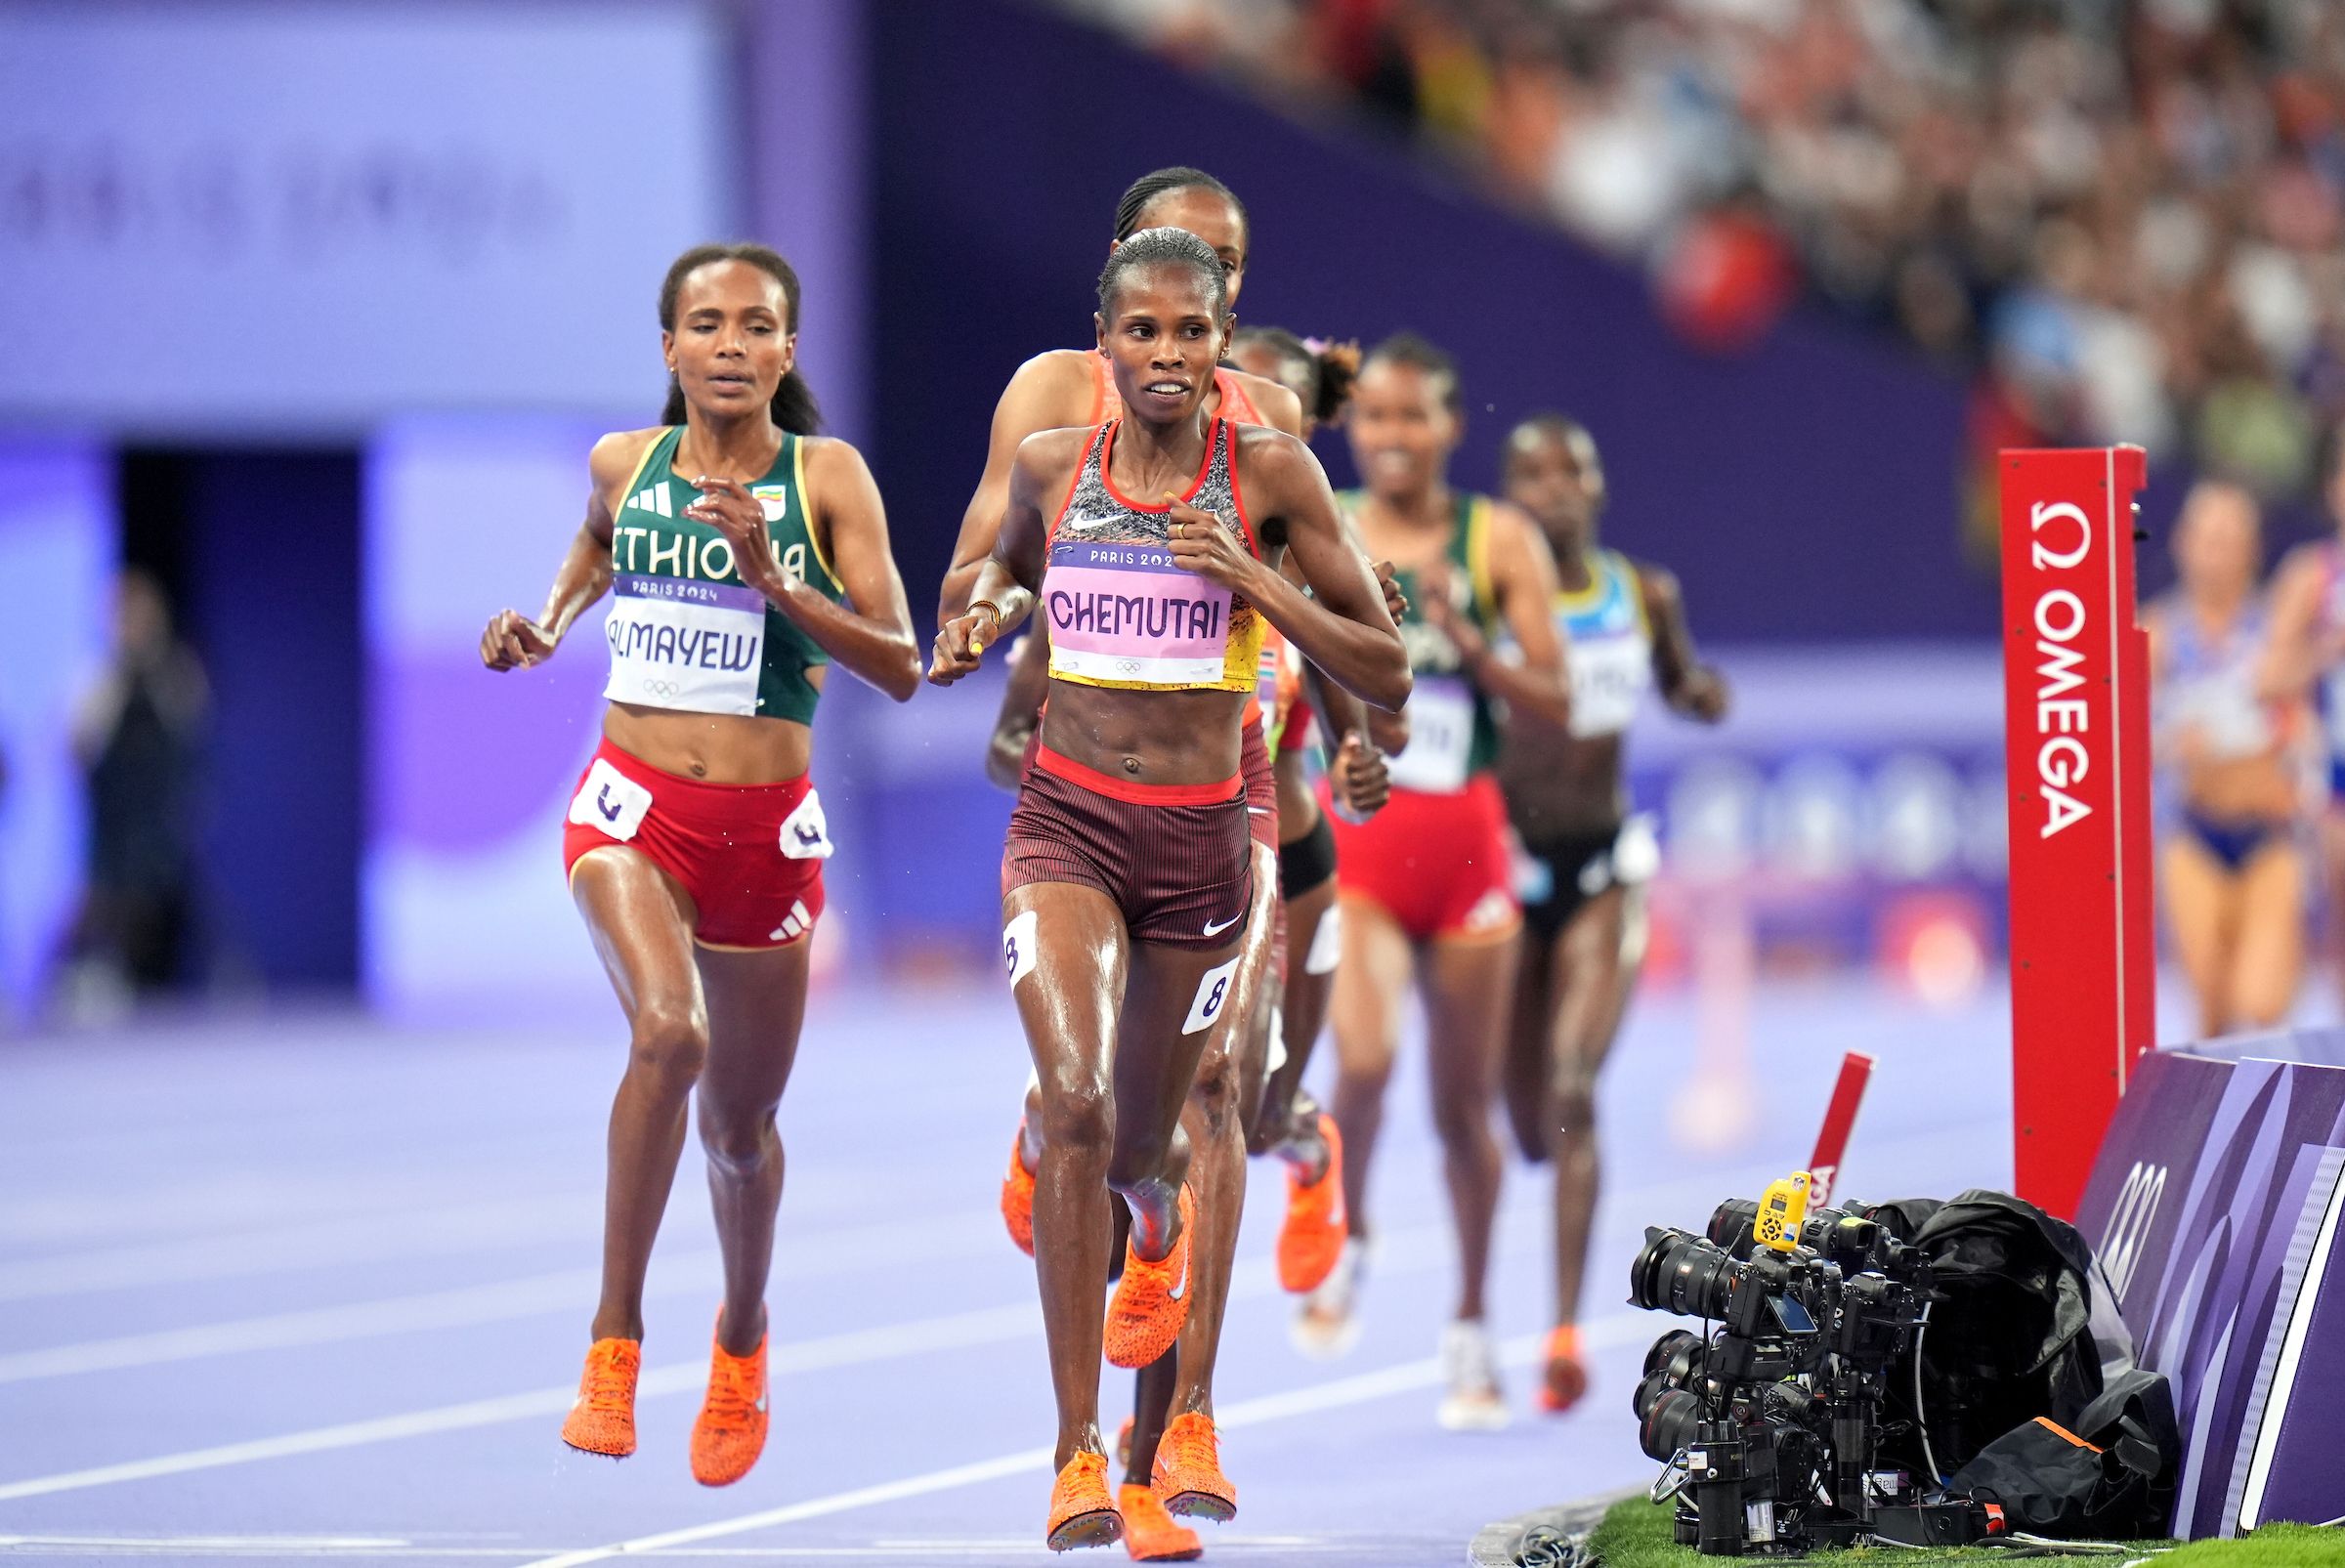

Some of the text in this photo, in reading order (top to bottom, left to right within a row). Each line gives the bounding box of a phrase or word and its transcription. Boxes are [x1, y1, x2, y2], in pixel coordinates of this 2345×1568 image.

[1089, 550, 1173, 568] PARIS 202
[632, 580, 718, 602] PARIS 2024
[1049, 589, 1220, 640] CHEMUTAI
[608, 617, 757, 673] ALMAYEW
[2033, 588, 2094, 840] OMEGA
[1005, 936, 1018, 978] 8
[1203, 976, 1227, 1017] 8
